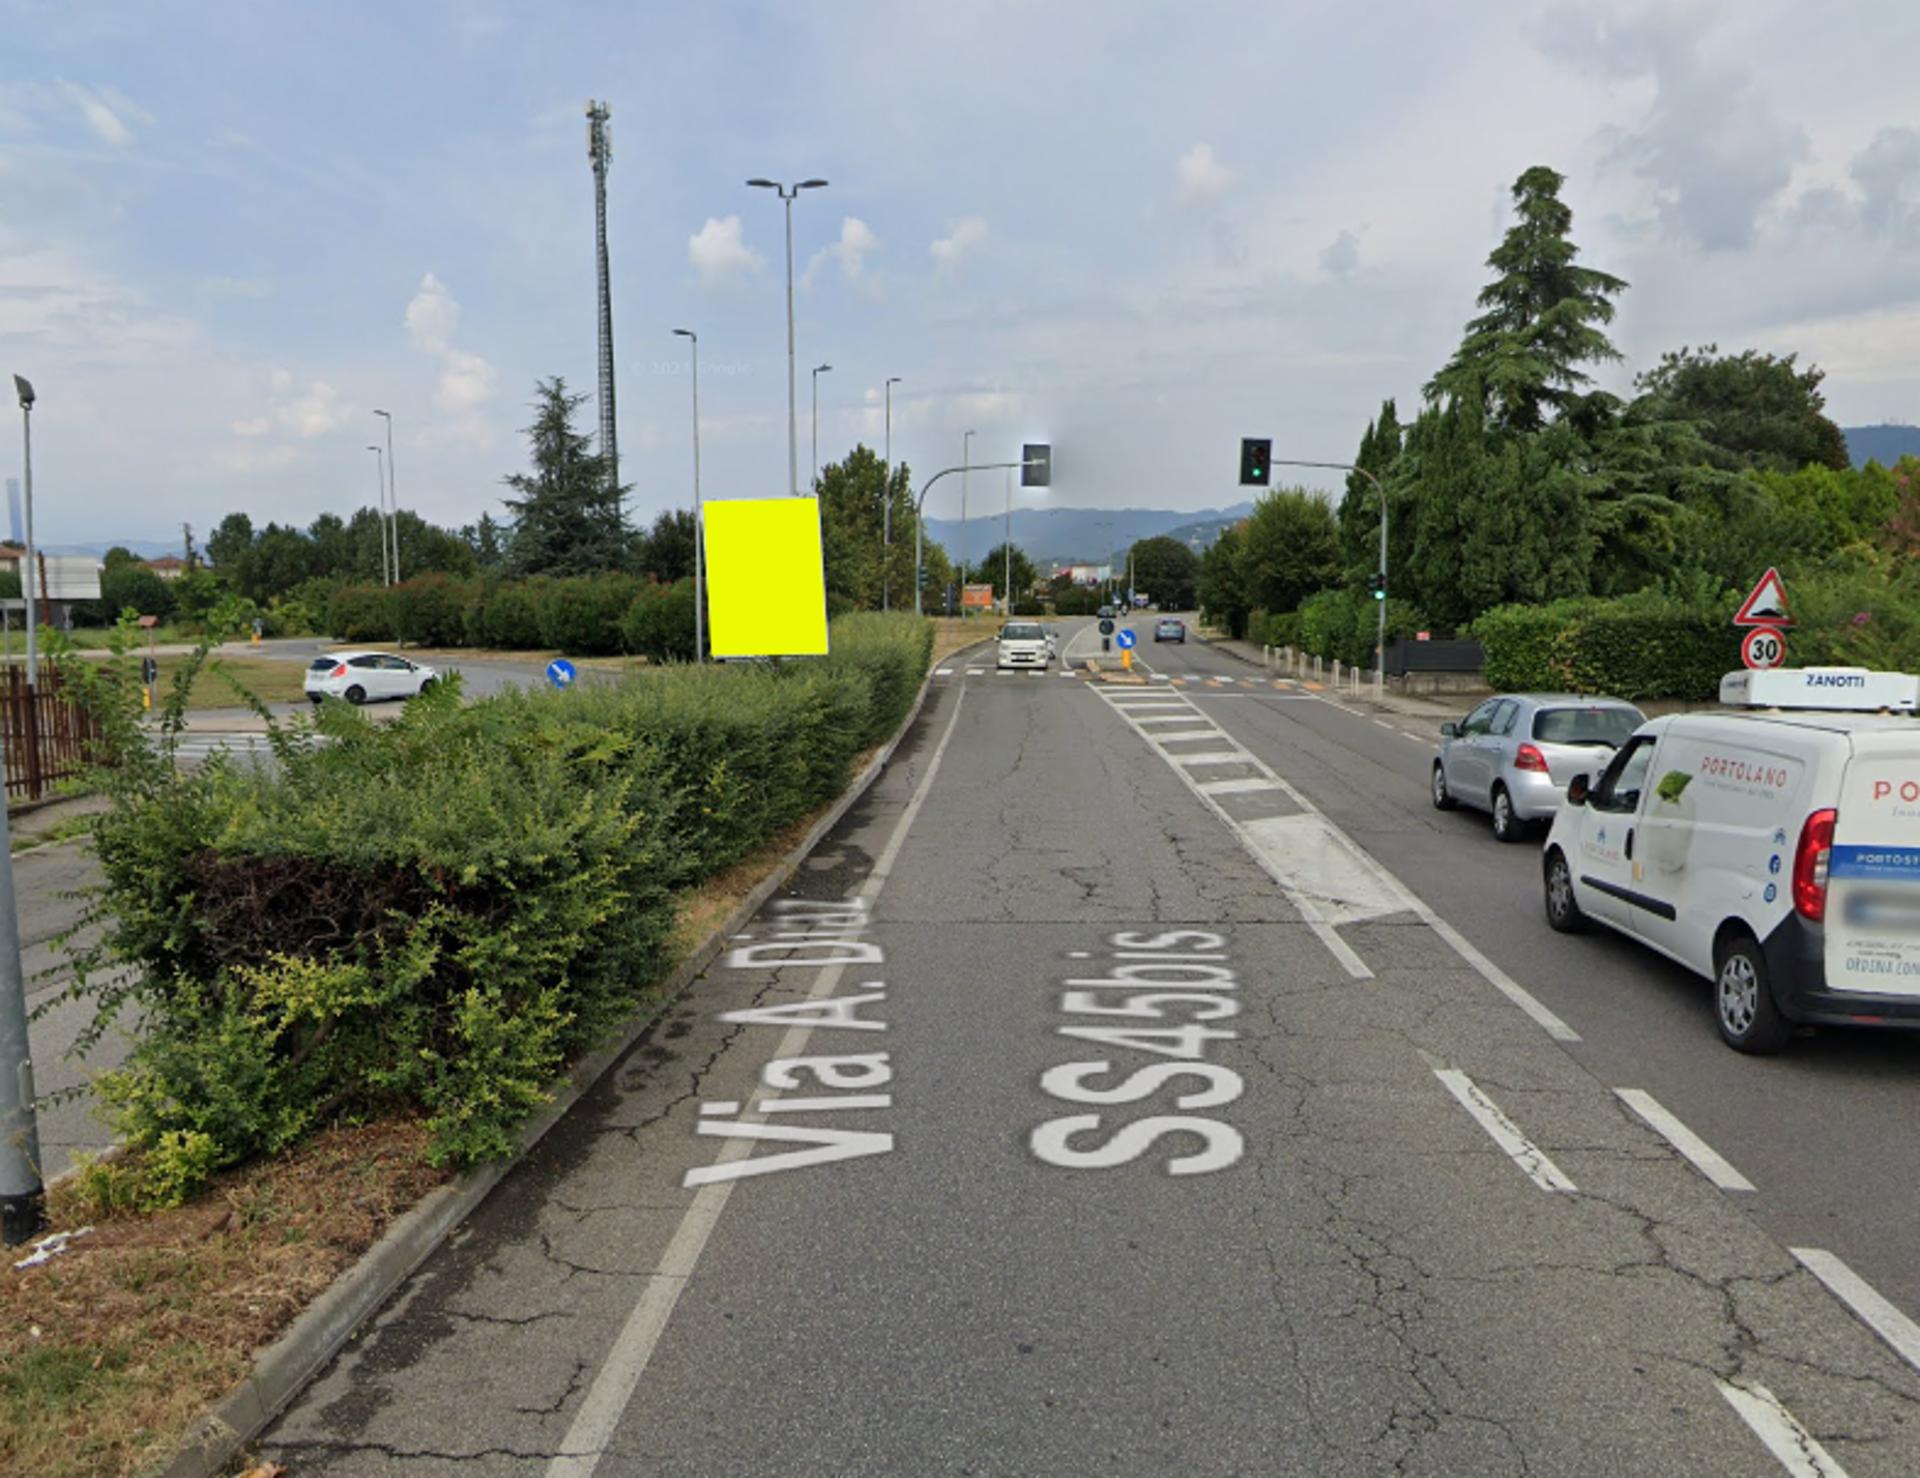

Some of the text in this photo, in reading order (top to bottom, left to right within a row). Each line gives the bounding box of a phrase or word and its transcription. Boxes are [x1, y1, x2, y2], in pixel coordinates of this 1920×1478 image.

[1753, 639, 1778, 660] 30
[1806, 674, 1865, 688] ZANOTTI
[1701, 757, 1787, 788] PORTOLANO
